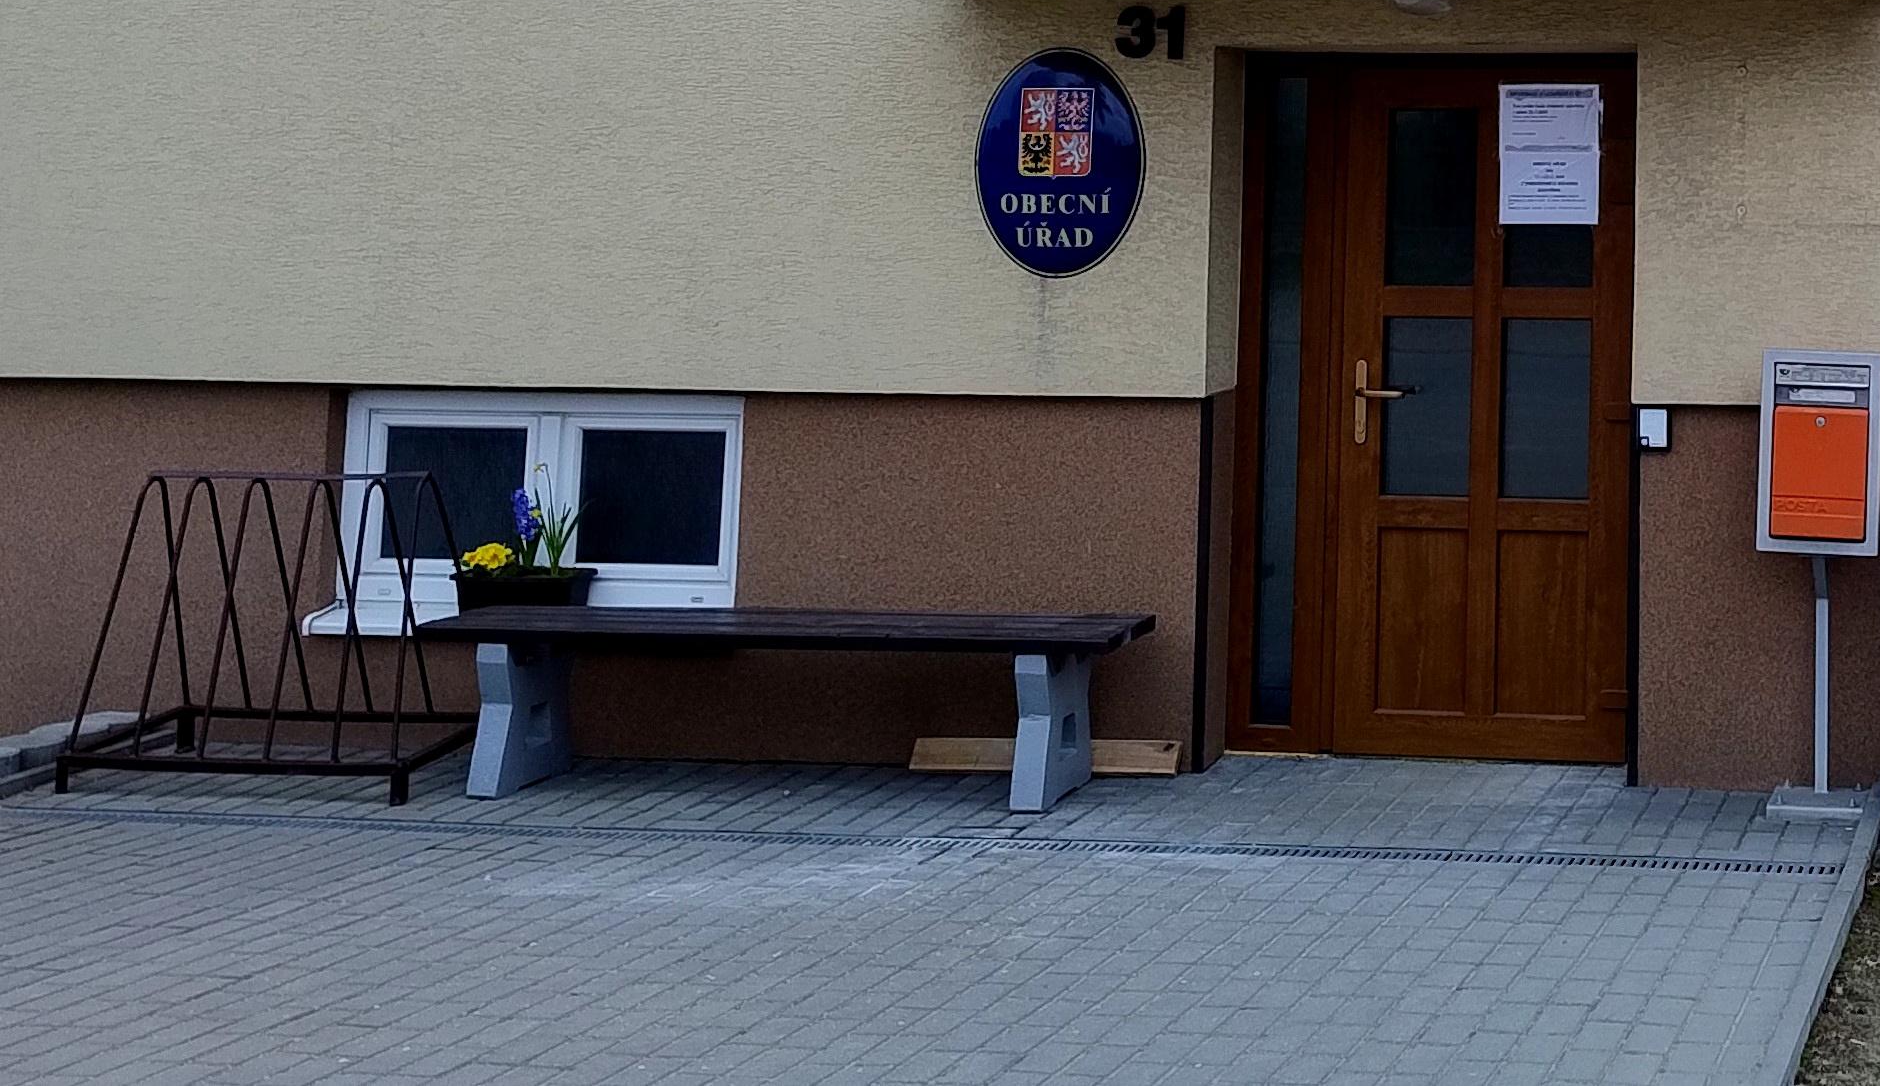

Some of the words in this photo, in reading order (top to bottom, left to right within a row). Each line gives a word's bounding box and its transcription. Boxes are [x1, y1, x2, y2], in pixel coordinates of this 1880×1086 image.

[1115, 5, 1186, 60] 31
[1000, 187, 1112, 215] OBECNÍ
[1015, 221, 1093, 248] ÚŘAD
